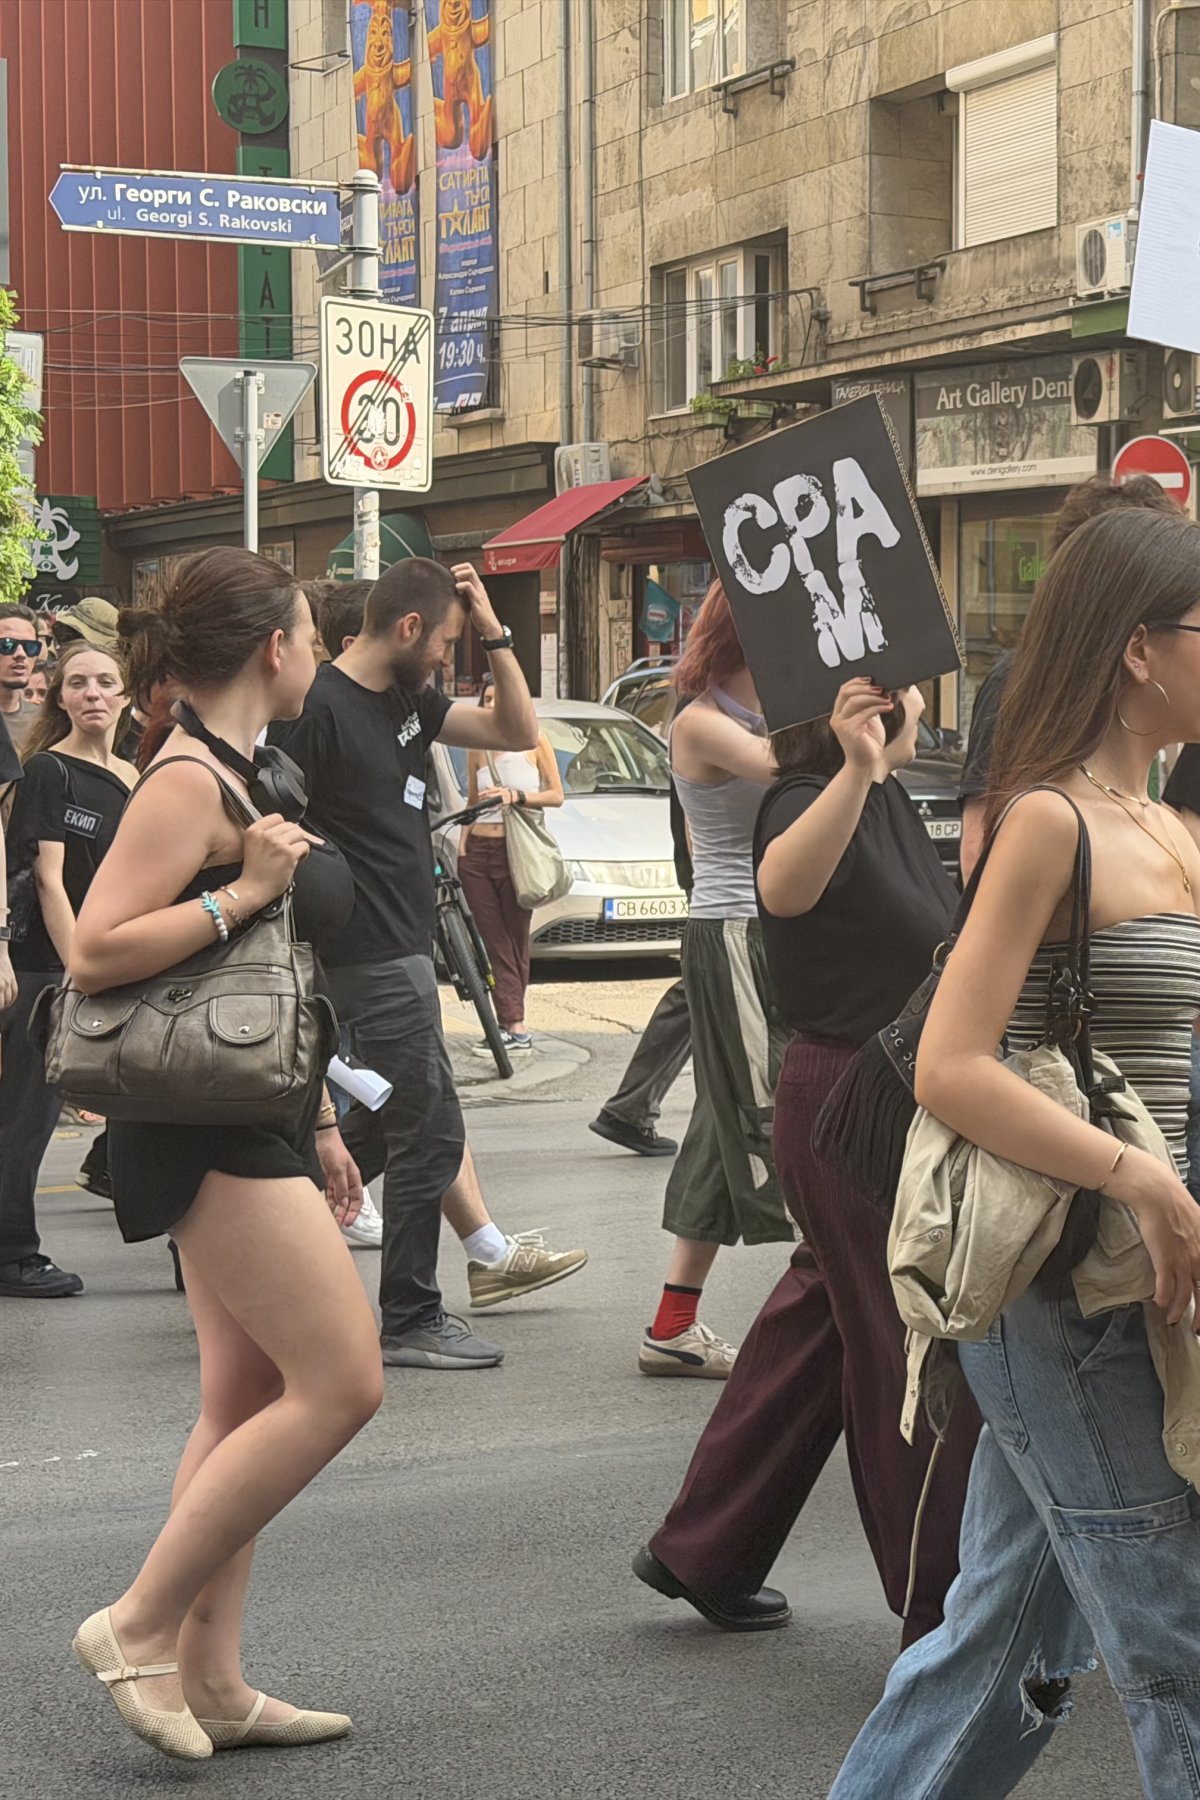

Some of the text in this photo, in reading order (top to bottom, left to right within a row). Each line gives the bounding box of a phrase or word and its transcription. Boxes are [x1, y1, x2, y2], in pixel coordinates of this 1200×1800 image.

[78, 184, 327, 216] ул. Георги С. Раковски
[108, 207, 292, 233] ul. Georgi S. Rakovski
[438, 306, 448, 335] 7
[336, 317, 420, 364] ЗОНА
[439, 338, 475, 370] 19:30
[936, 375, 1073, 411] Art Gallery Deni
[64, 809, 97, 831] ЕКИП
[640, 900, 677, 916] 6603
